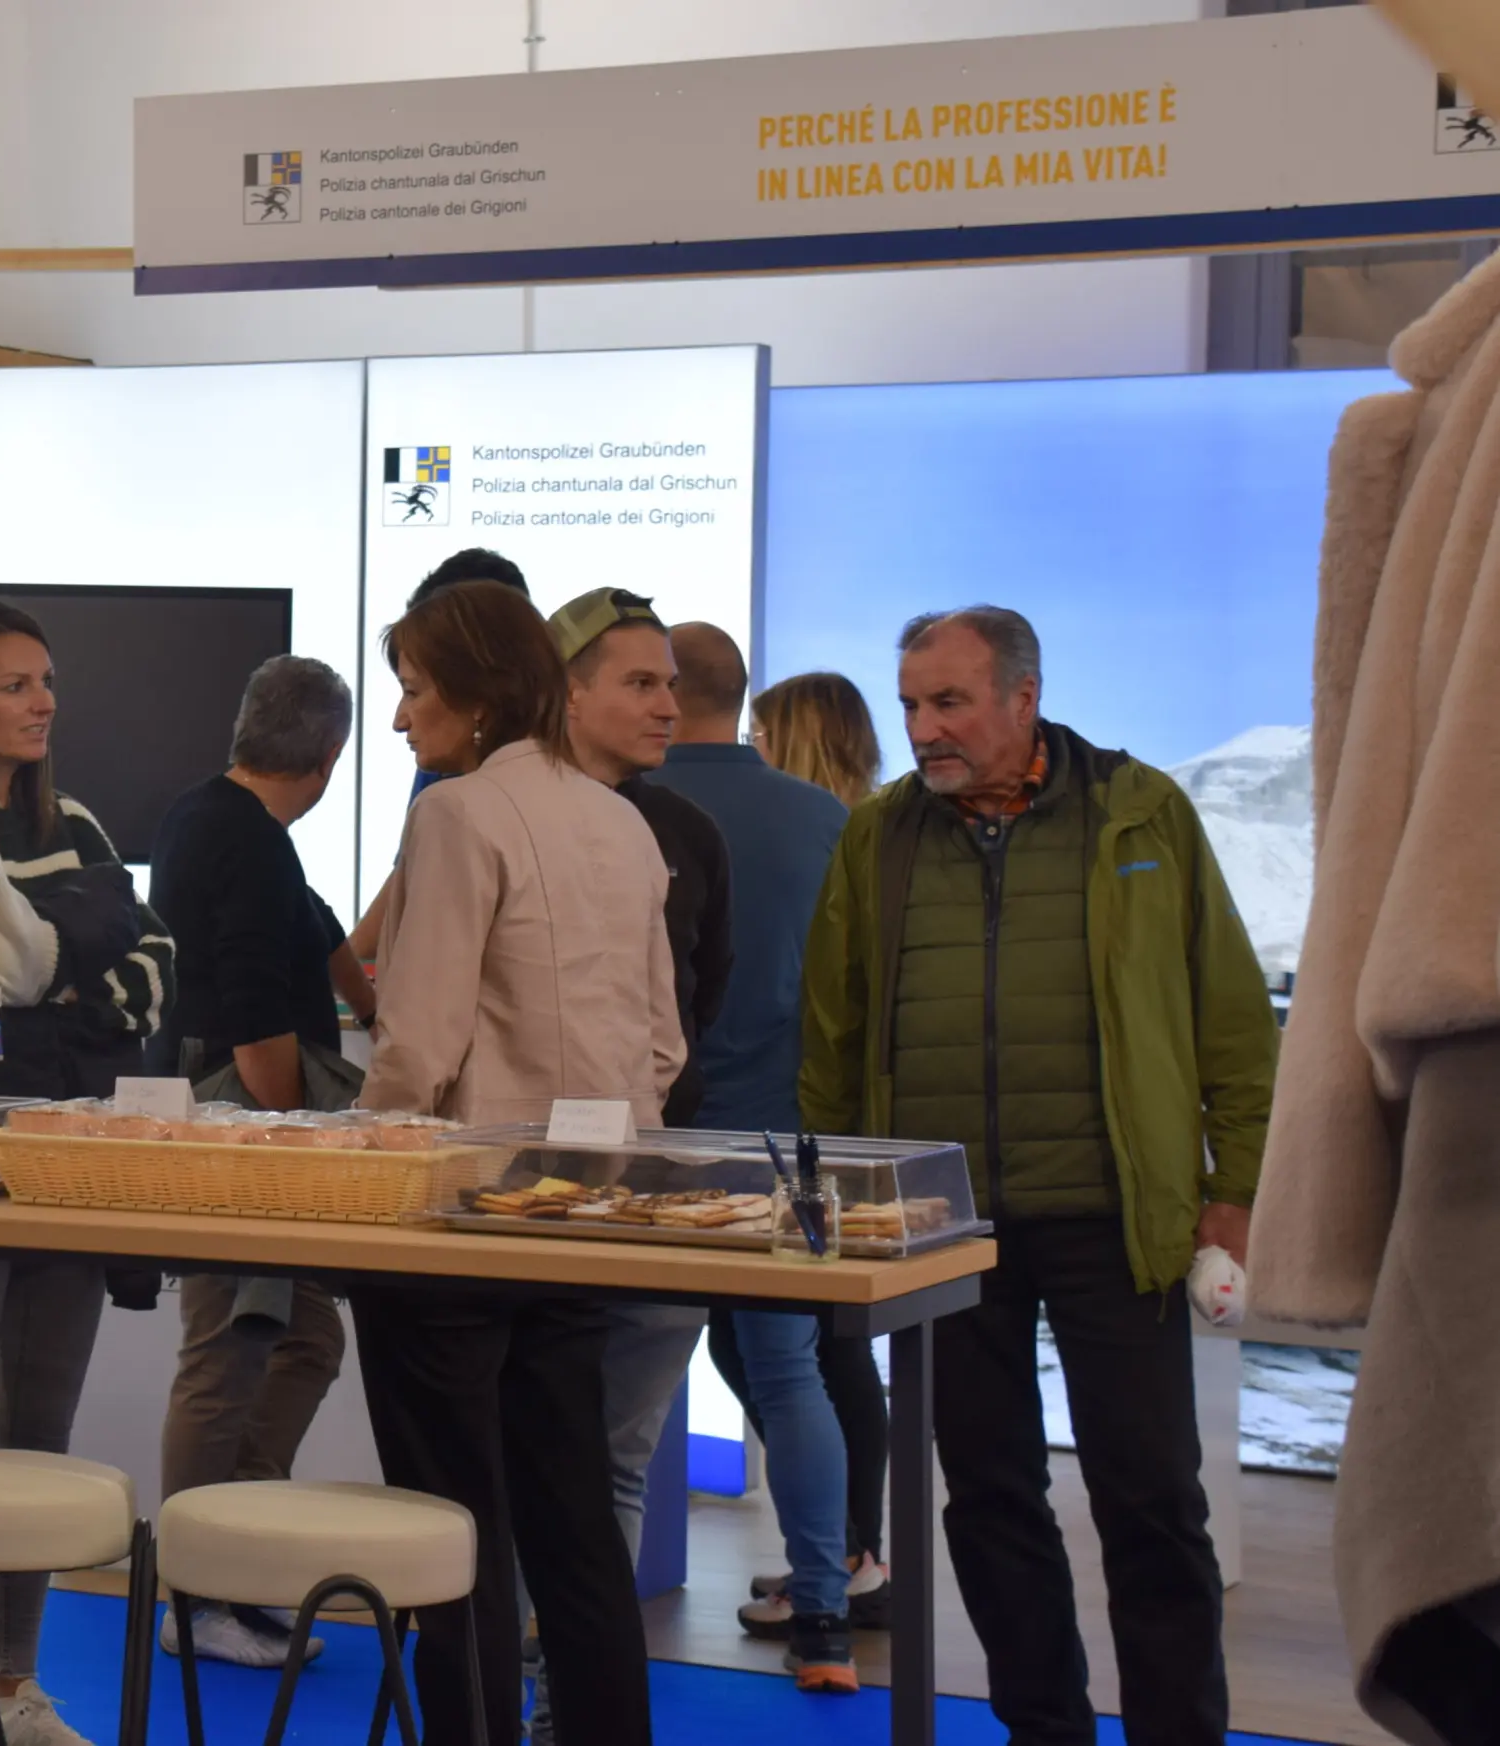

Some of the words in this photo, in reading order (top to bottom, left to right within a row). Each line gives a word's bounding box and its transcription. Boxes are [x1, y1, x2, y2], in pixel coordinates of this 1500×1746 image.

[758, 104, 874, 150] PERCHÉ
[883, 107, 923, 143] LA
[931, 90, 1150, 138] PROFESSIONE
[1159, 82, 1177, 123] È
[320, 144, 424, 164] Kantonspolizei
[428, 140, 519, 159] Graubünden
[320, 178, 367, 192] Polizia
[370, 173, 450, 190] chantunala
[453, 172, 476, 186] dal
[480, 168, 546, 185] Grischun
[757, 168, 788, 201] IN
[797, 162, 884, 200] LINEA
[893, 158, 955, 194] CON
[965, 155, 1004, 189] LA
[1014, 149, 1074, 188] MIA
[1083, 143, 1168, 182] VITA!
[319, 207, 366, 222] Polizia
[370, 203, 441, 219] cantonale
[444, 201, 466, 216] dei
[470, 198, 527, 217] Grigioni
[472, 444, 594, 462] Kantonspolizei
[599, 442, 706, 458] Graubünden
[472, 477, 526, 493] Polizia
[531, 475, 623, 493] chantunala
[628, 474, 654, 491] dal
[660, 474, 737, 490] Grischun
[471, 511, 525, 526] Polizia
[530, 509, 612, 525] cantonale
[618, 508, 643, 524] dei
[649, 508, 715, 527] Grigioni
